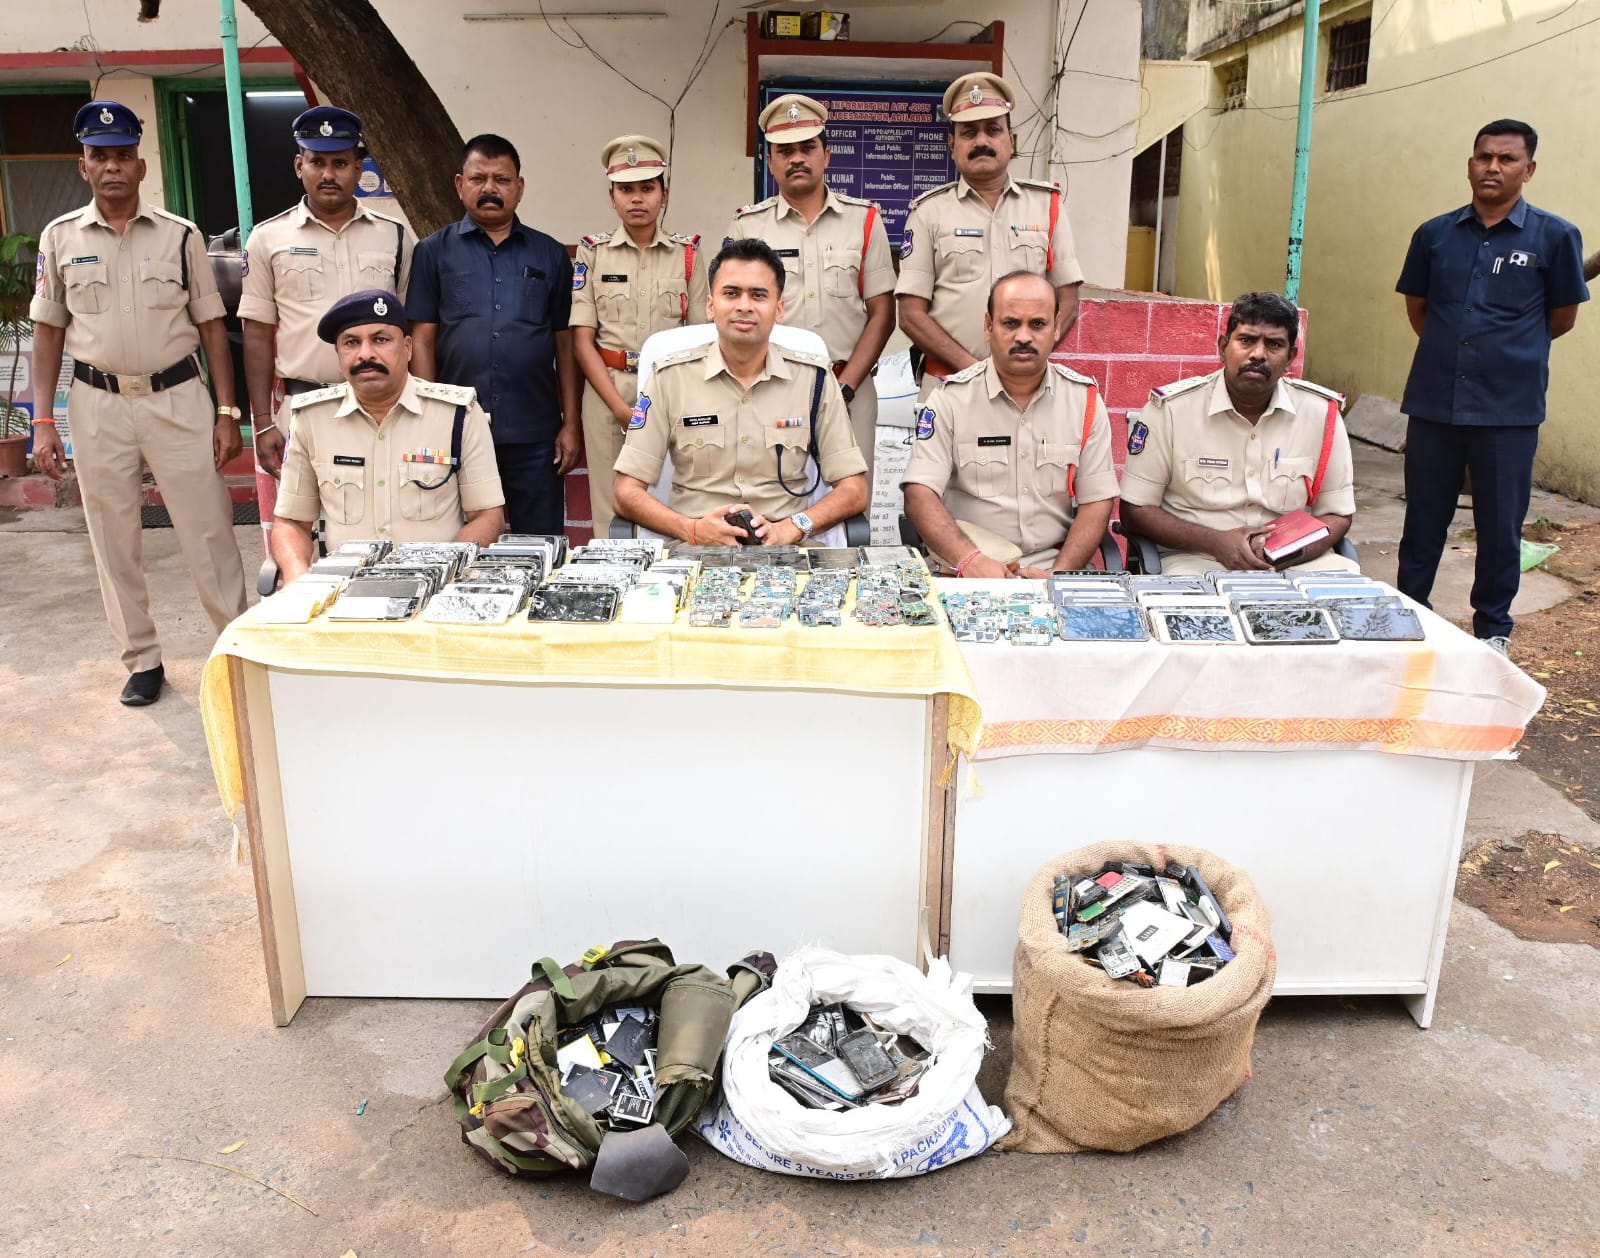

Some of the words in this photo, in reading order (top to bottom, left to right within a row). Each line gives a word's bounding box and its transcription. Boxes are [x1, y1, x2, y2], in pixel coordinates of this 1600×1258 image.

[831, 101, 890, 111] INFORMATION
[890, 102, 908, 111] ACT
[831, 129, 857, 138] OFFICER
[918, 132, 944, 141] PHONE
[865, 152, 893, 160] Information
[893, 153, 911, 161] Officer
[831, 173, 854, 184] KUMAR
[880, 173, 896, 181] Public
[864, 182, 892, 190] Information
[892, 183, 910, 191] Officer
[795, 1163, 802, 1172] 3
[806, 1166, 855, 1180] YEARS
